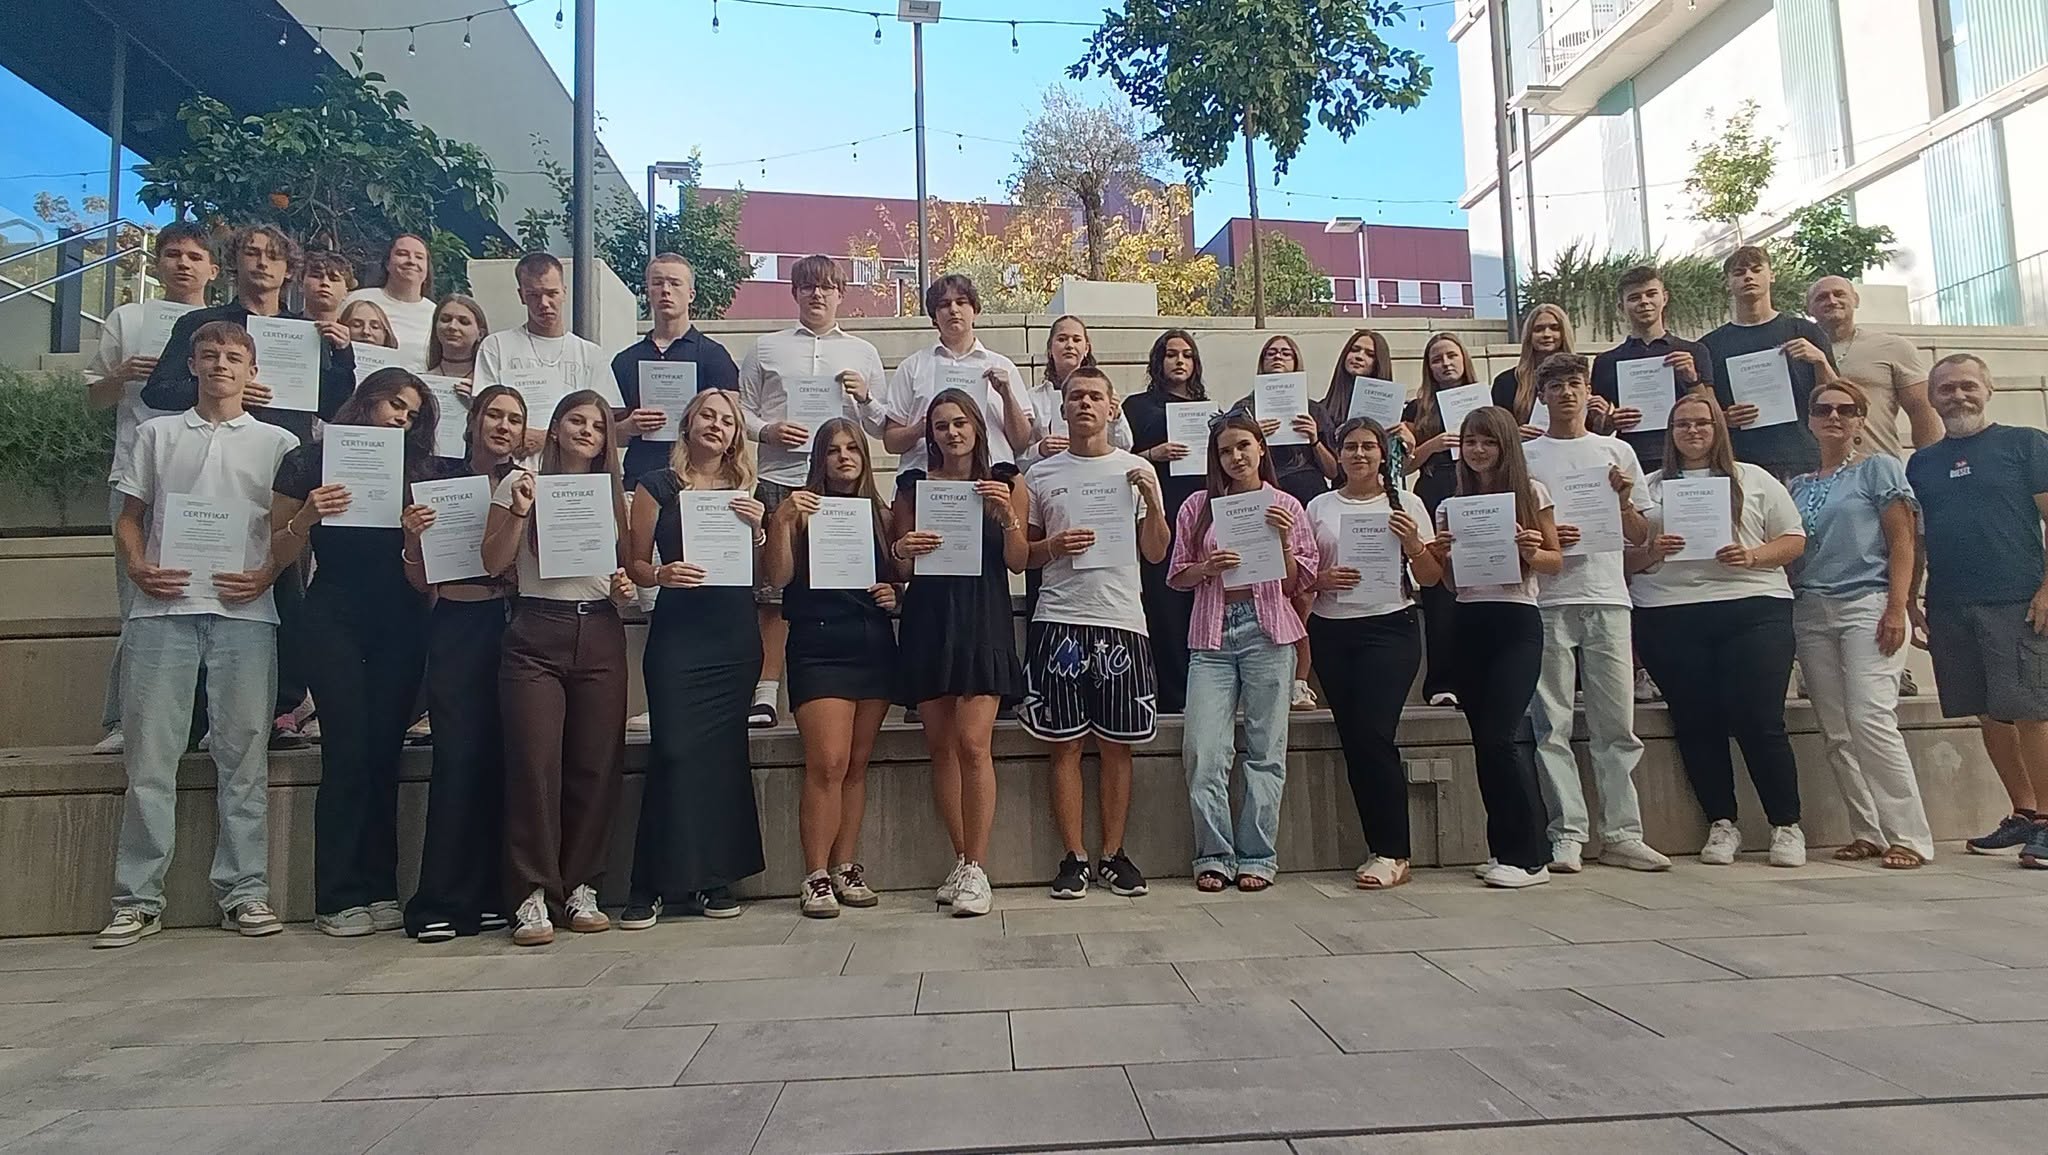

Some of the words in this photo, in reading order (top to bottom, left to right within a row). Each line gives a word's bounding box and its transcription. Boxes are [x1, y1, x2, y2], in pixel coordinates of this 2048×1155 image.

[263, 331, 304, 340] CERTYFIKAT
[650, 373, 683, 381] CERTYFIKAT
[945, 376, 977, 385] CERTYFIKAT
[1364, 388, 1394, 398] CERTYFIKAT
[341, 439, 385, 448] CERTYFIKAT
[551, 490, 594, 498] CERTYFIKAT
[1082, 487, 1117, 496] CERTYFIKAT
[431, 493, 473, 504] CERTYFIKAT
[930, 493, 967, 502] CERTYFIKAT
[182, 510, 230, 520] CERTYFIKAT
[822, 509, 857, 517] CERTYFIKAT
[1226, 504, 1261, 518] CERTYFIKAT
[1461, 507, 1499, 517] CERTYFIKAT
